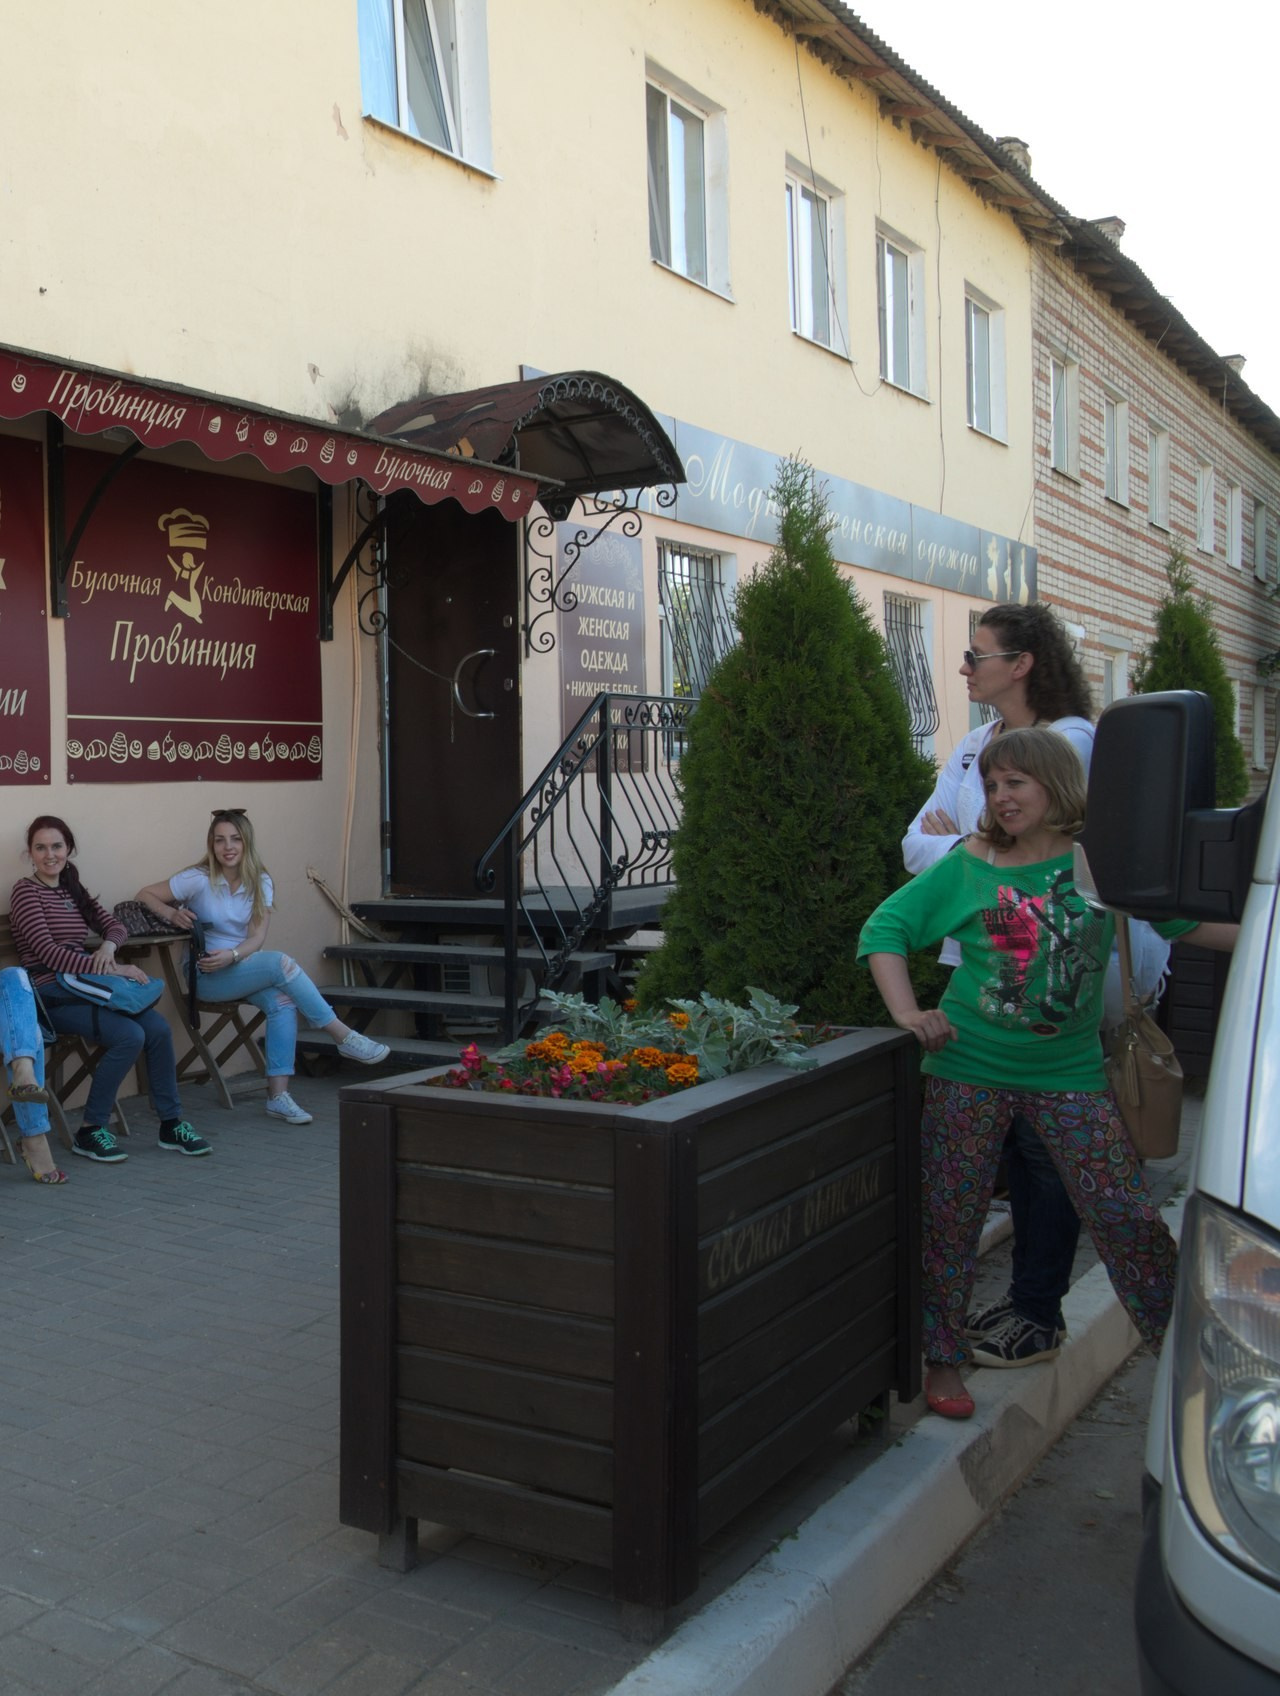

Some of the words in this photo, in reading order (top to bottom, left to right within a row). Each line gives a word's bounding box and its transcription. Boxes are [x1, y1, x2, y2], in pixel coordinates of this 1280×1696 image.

[47, 369, 188, 436] Провинция
[374, 447, 453, 492] Булочная
[917, 538, 978, 592] одежда
[71, 561, 162, 604] Булочная
[202, 575, 310, 621] Кондитерская
[569, 582, 625, 607] МУЖСКАЯ
[627, 591, 635, 611] И
[110, 621, 257, 684] Провинция
[578, 616, 630, 641] ЖЕНСКАЯ
[581, 648, 629, 674] ОДЕЖДА
